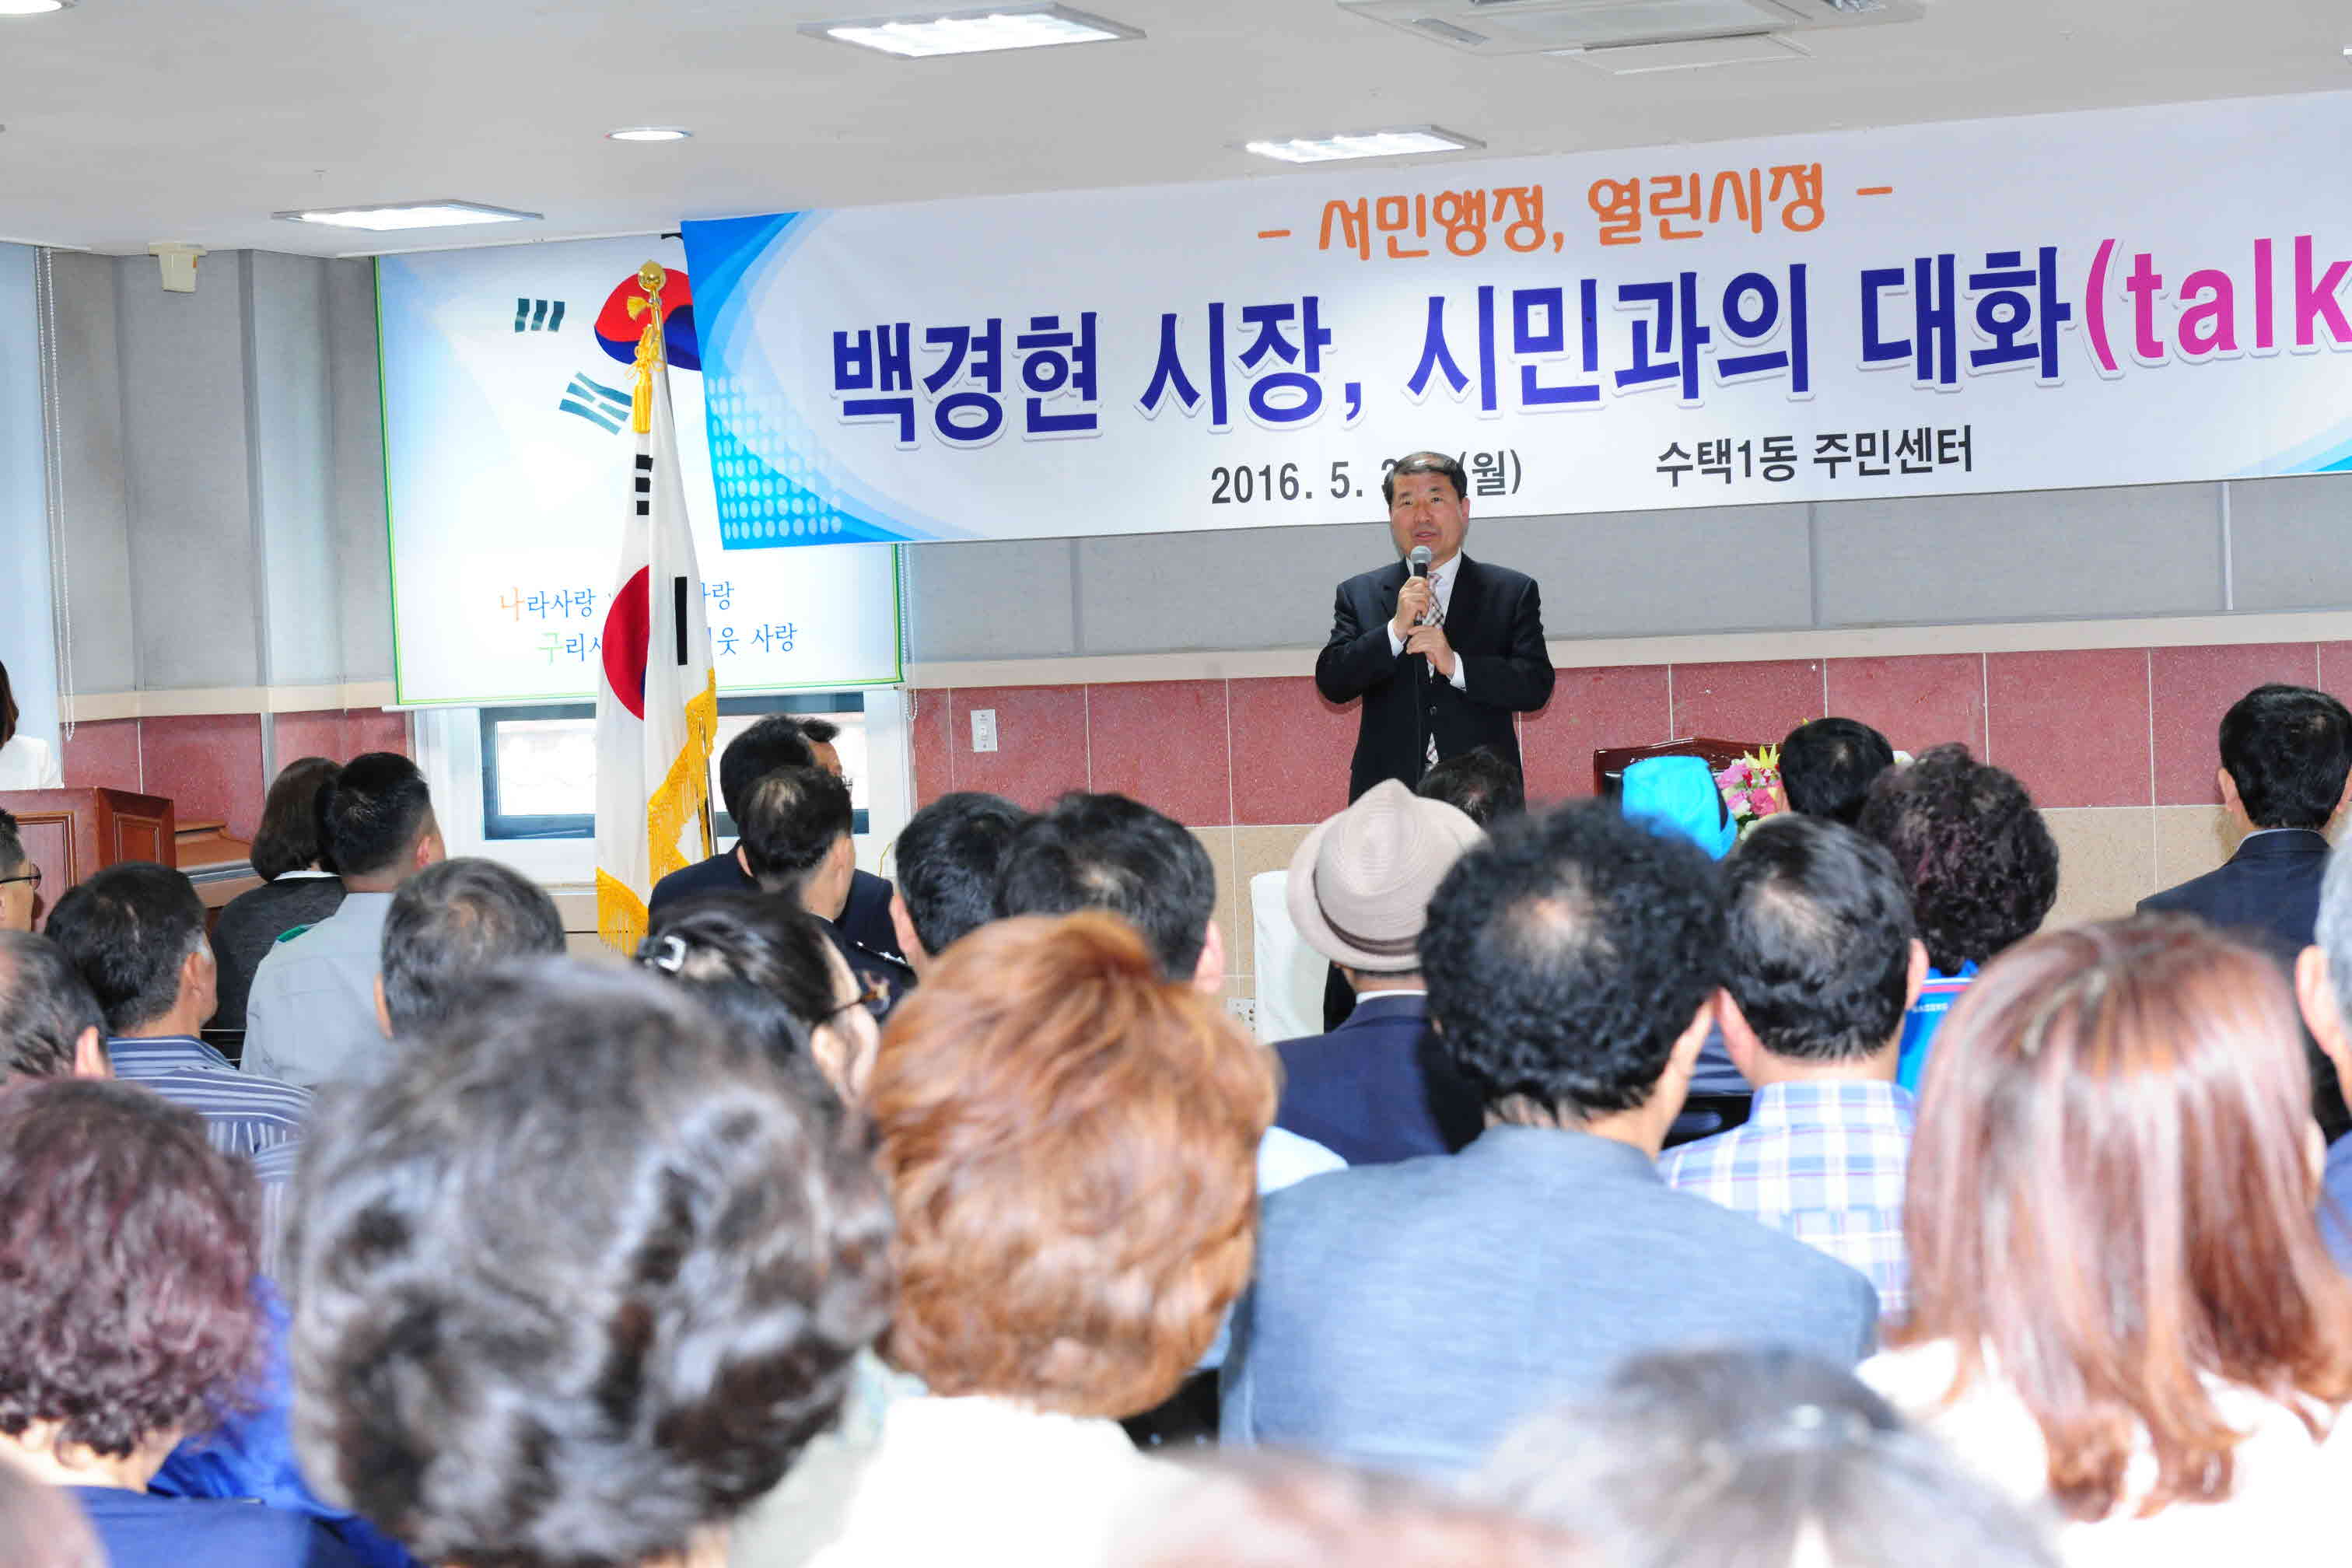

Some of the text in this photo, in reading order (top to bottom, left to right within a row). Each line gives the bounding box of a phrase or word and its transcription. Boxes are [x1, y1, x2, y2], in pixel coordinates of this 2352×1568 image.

[1318, 184, 1565, 261] 서민행정,
[1587, 162, 1825, 247] 열린시정
[832, 311, 1098, 443] 백경현
[1139, 296, 1361, 426] 시장,
[1406, 263, 1809, 412] 시민과의
[1210, 462, 1313, 505] 2016.
[1330, 460, 1363, 499] 5.
[1656, 435, 1798, 488] 수택1동
[1812, 424, 1972, 480] 주민센터
[499, 586, 597, 621] 나라사랑
[751, 622, 798, 653] 사랑
